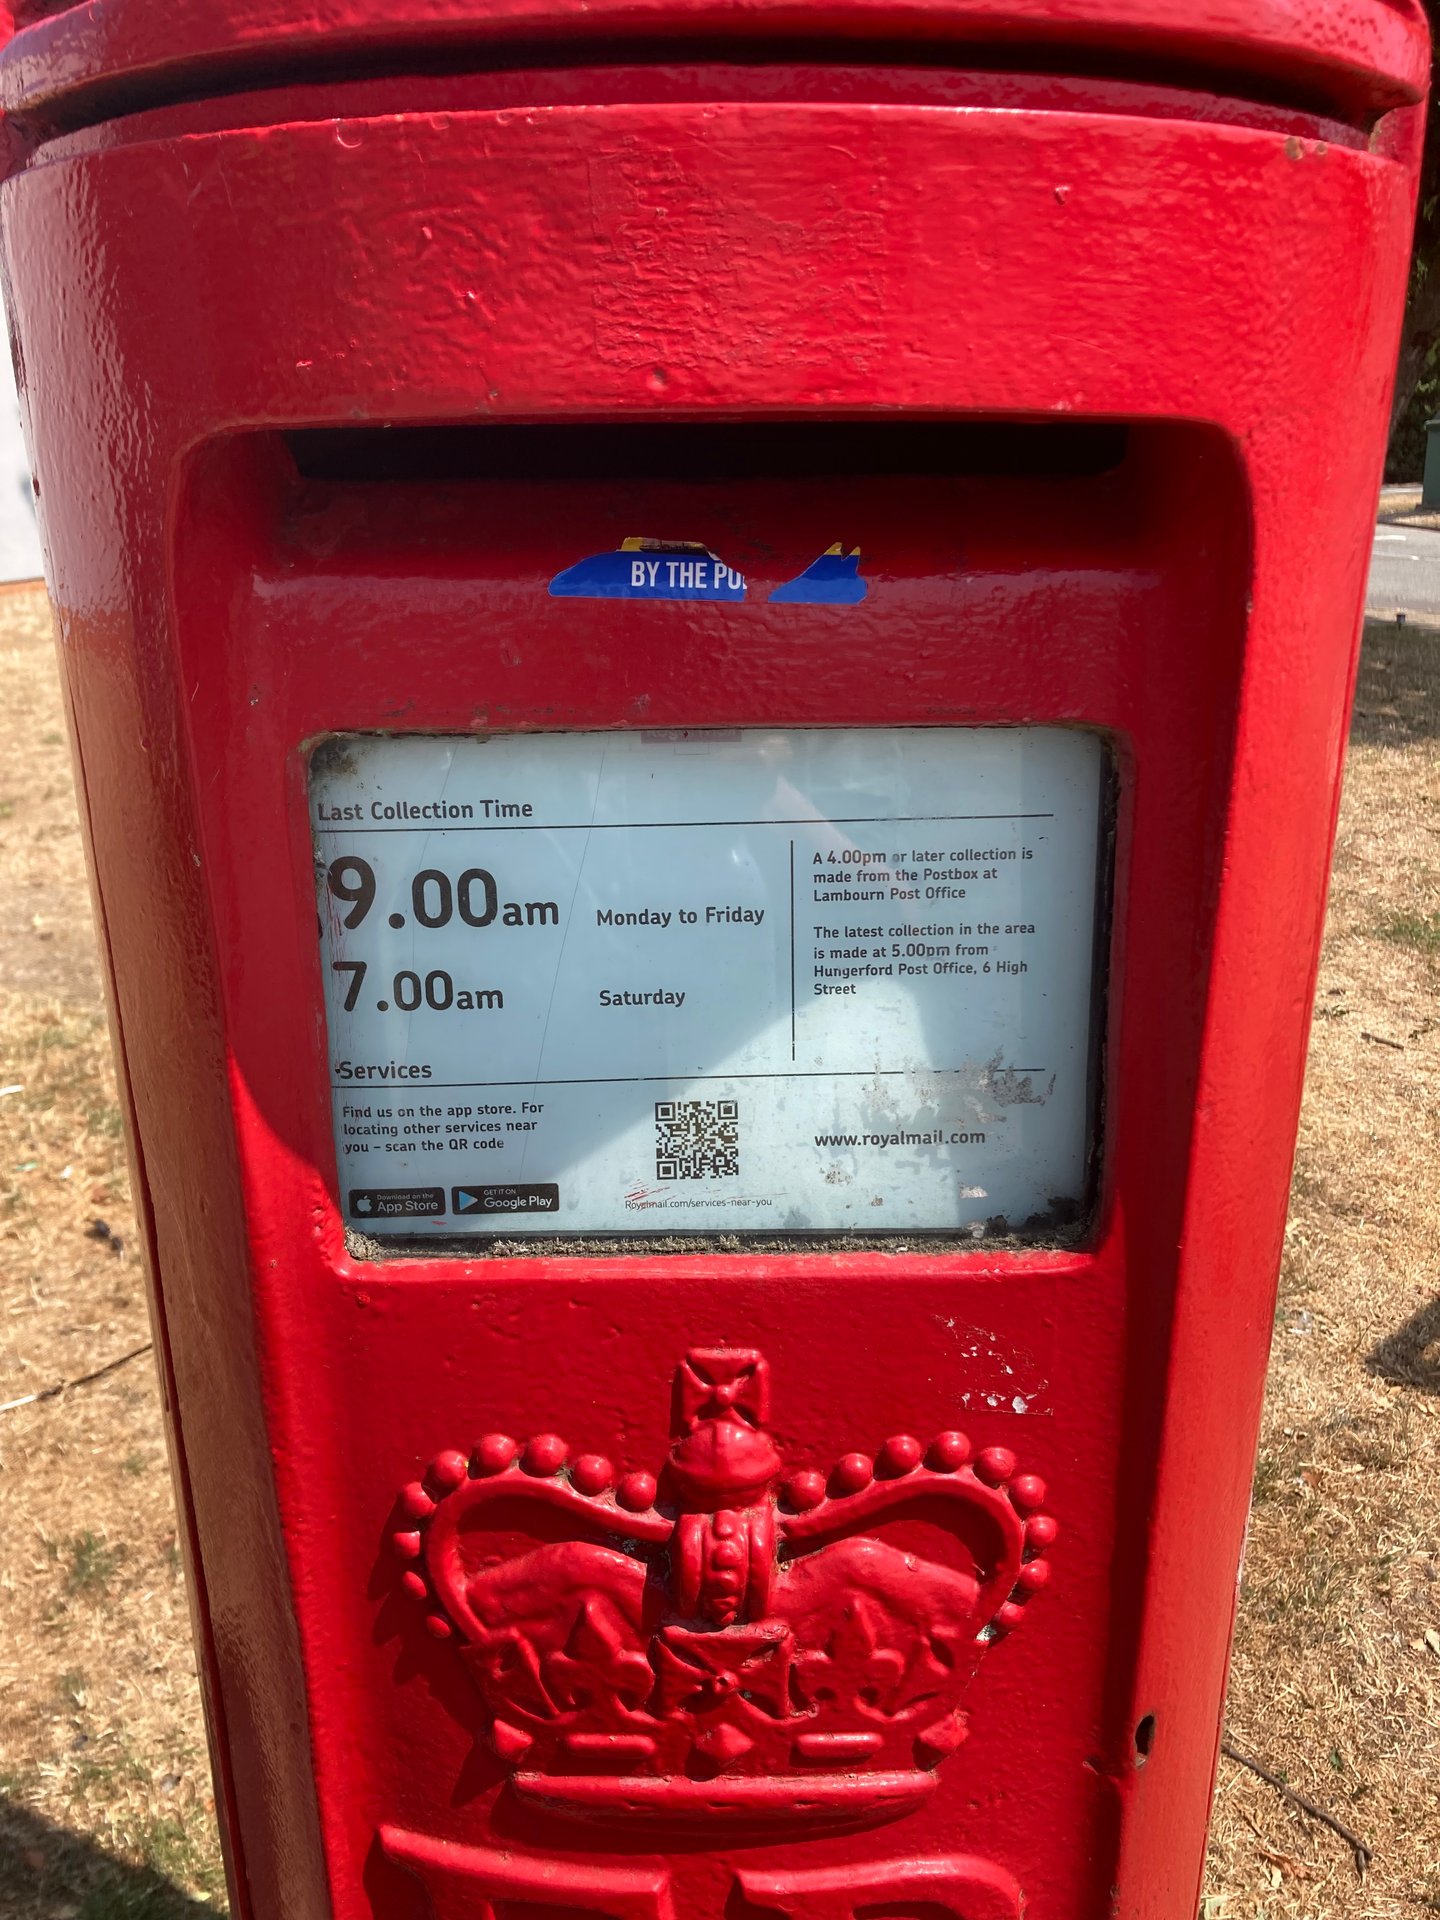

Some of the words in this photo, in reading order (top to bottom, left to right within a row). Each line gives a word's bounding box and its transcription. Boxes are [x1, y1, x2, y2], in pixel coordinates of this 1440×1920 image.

[631, 561, 660, 587] BY
[666, 562, 707, 588] THE
[318, 802, 363, 821] Last
[371, 801, 473, 820] Collection
[480, 799, 533, 818] Time
[813, 852, 822, 865] A
[827, 850, 887, 866] 4.00pm
[892, 852, 907, 863] or
[912, 850, 945, 862] later
[950, 848, 1016, 861] collection
[1022, 847, 1033, 860] is
[814, 870, 852, 883] made
[857, 870, 890, 882] from
[896, 869, 918, 881] the
[924, 867, 978, 881] Postbox
[983, 867, 998, 879] at
[327, 856, 559, 929] 9.00am
[814, 889, 884, 902] Lambourn
[890, 887, 920, 900] Post
[926, 886, 966, 899] Office
[597, 909, 672, 928] Monday
[679, 909, 698, 924] to
[706, 906, 765, 926] Friday
[814, 926, 839, 939] The
[845, 925, 883, 938] latest
[888, 923, 954, 937] collection
[959, 923, 972, 935] in
[977, 922, 999, 935] the
[1005, 923, 1035, 934] area
[814, 947, 825, 960] is
[830, 946, 867, 959] made
[873, 947, 886, 958] at
[892, 943, 950, 958] 5.00pm
[955, 944, 989, 956] from
[814, 964, 893, 979] Hungerford
[898, 963, 928, 976] Post
[933, 962, 977, 976] Office,
[982, 961, 991, 973] 6
[996, 960, 1028, 975] High
[333, 961, 504, 1011] 7.00am
[814, 982, 856, 995] Street
[600, 988, 686, 1007] Saturday
[339, 1061, 432, 1079] Services
[343, 1105, 372, 1118] Find
[377, 1107, 392, 1118] us
[398, 1107, 415, 1117] on
[420, 1105, 442, 1117] the
[447, 1105, 472, 1119] app
[477, 1103, 517, 1116] store.
[521, 1102, 544, 1114] For
[344, 1124, 398, 1137] locating
[403, 1122, 440, 1135] other
[445, 1121, 501, 1134] services
[506, 1120, 538, 1132] near
[344, 1142, 369, 1155] you
[385, 1141, 416, 1152] scan
[421, 1140, 444, 1152] the
[449, 1138, 468, 1151] QR
[473, 1137, 504, 1150] code
[815, 1130, 986, 1149] www.royalmail.com
[377, 1201, 402, 1214] App
[405, 1200, 438, 1211] Store
[484, 1196, 526, 1210] Google
[529, 1195, 552, 1208] Play
